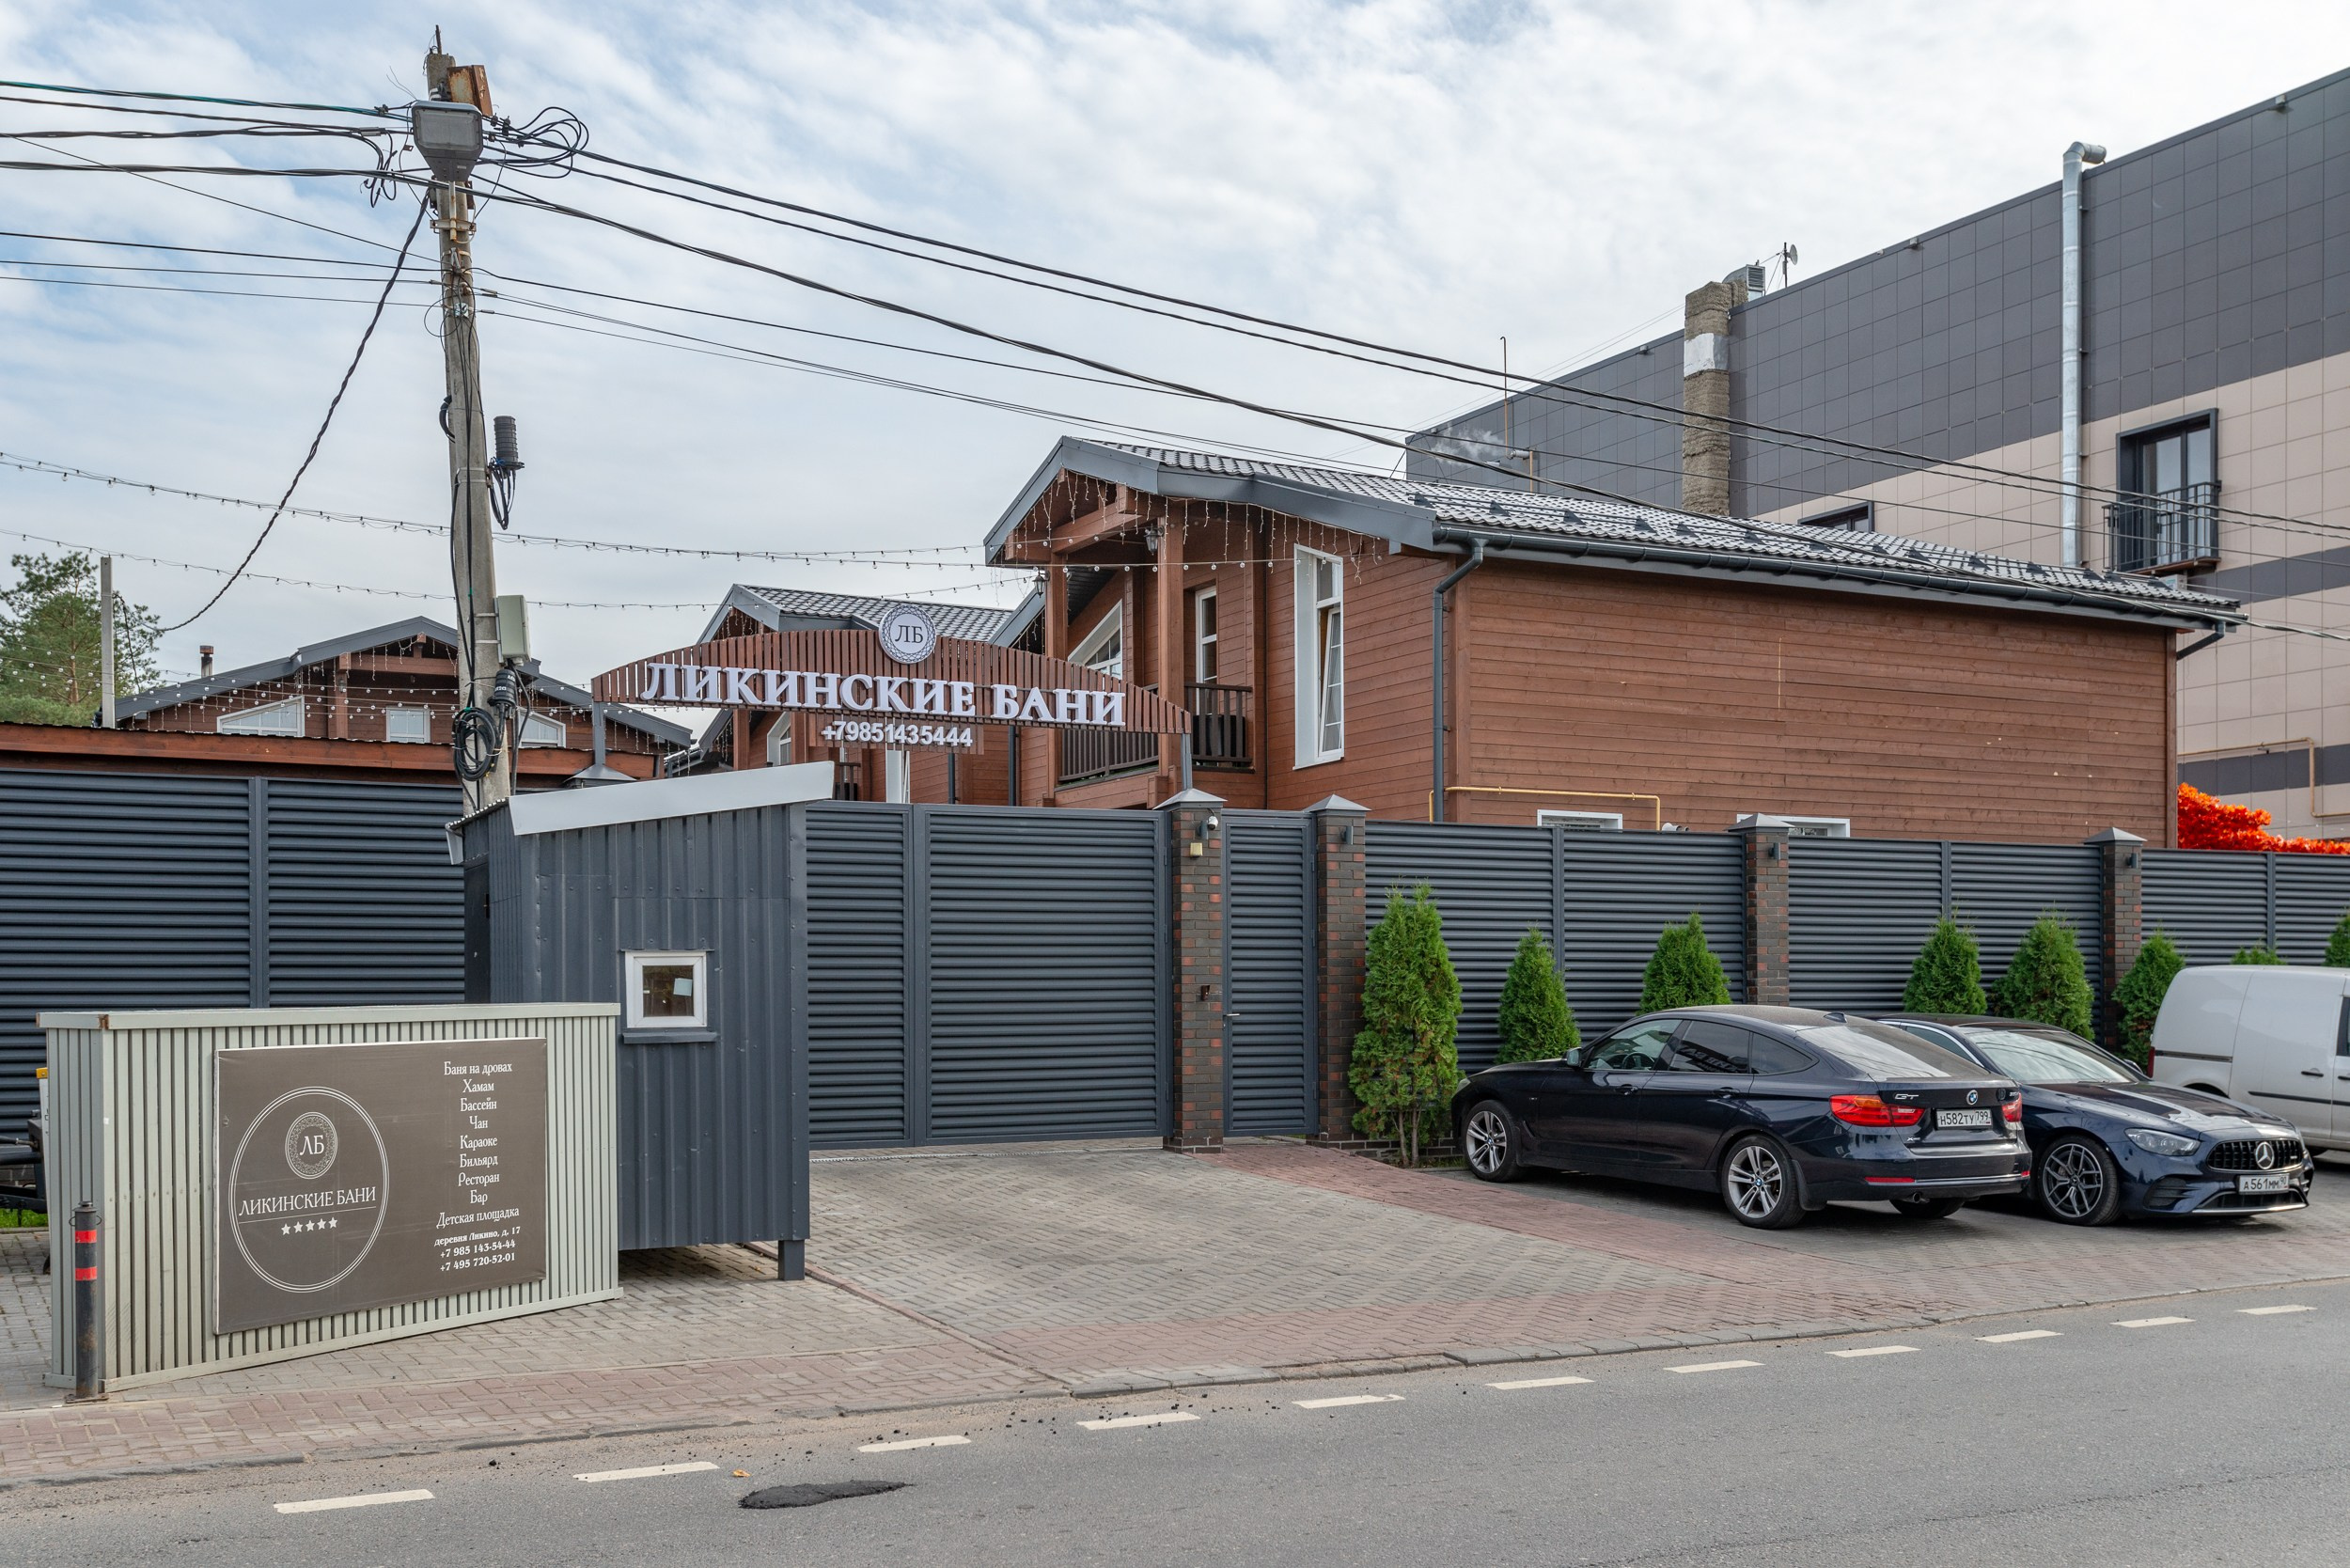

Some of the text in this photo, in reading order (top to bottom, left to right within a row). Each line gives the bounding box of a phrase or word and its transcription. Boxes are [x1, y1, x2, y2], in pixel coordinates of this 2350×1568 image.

[894, 623, 924, 645] ЛБ
[640, 662, 1126, 727] ЛИКИНСКИЕ БАНИ
[821, 720, 974, 748] +79851435444
[444, 1060, 513, 1076] Баня на дровах
[462, 1078, 494, 1093] Хамам
[460, 1096, 497, 1112] Бассейн
[469, 1115, 489, 1129] Чан
[1940, 1112, 1974, 1125] Н582ТУ
[299, 1135, 325, 1156] ЛБ
[460, 1135, 498, 1152] Караоке
[460, 1152, 499, 1168] Бильярд
[458, 1171, 500, 1187] Ресторан
[239, 1186, 376, 1216] ЛИКИНСКИЕ БАНИ
[470, 1189, 488, 1205] Бар
[436, 1207, 520, 1229] Детская площадка
[433, 1226, 521, 1247] деревня Ликино, д. 17
[440, 1238, 516, 1259] +7 985 143-54-44
[440, 1252, 516, 1272] +7 495 720-52-01
